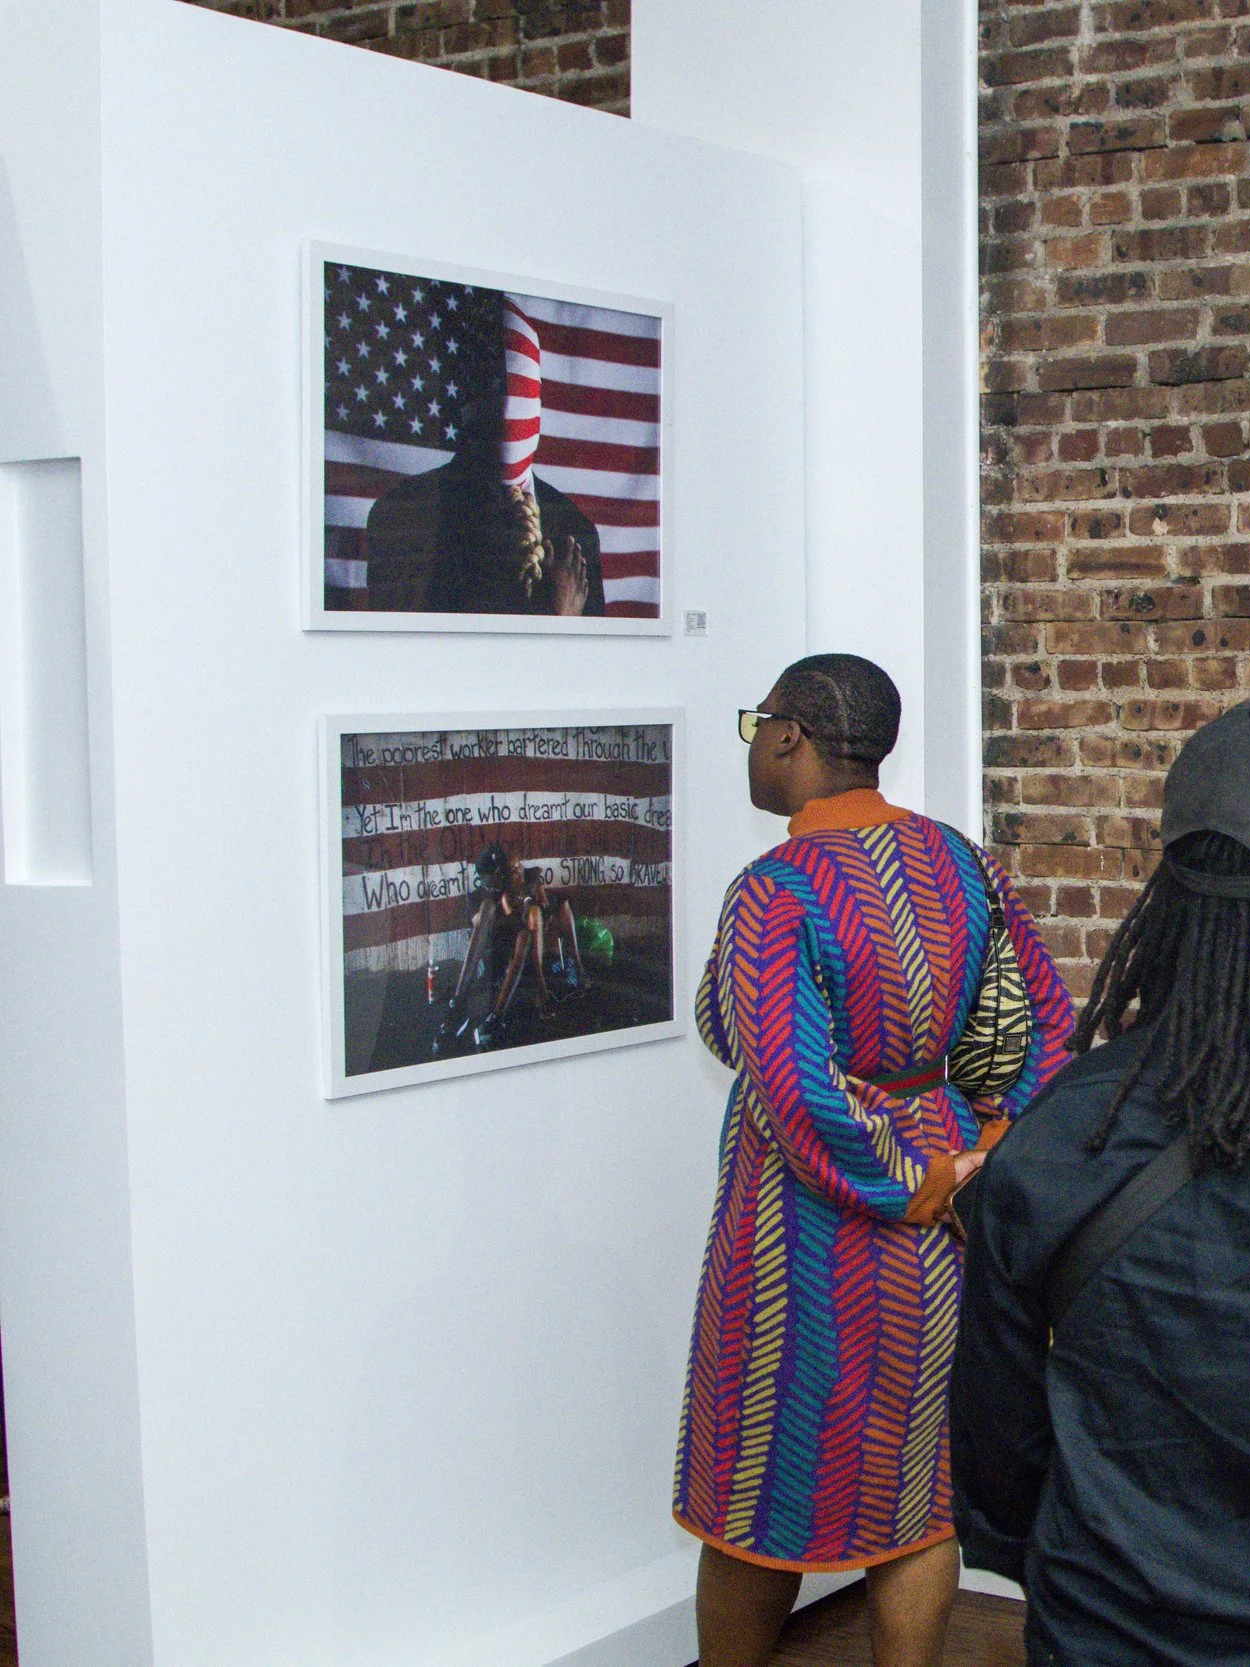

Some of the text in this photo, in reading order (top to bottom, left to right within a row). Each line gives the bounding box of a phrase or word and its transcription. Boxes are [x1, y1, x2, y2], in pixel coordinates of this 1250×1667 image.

[381, 733, 447, 767] poorest
[450, 730, 503, 760] worker
[506, 728, 569, 757] bartered
[633, 729, 657, 761] the
[355, 804, 380, 835] Yet
[414, 801, 441, 829] the
[445, 807, 472, 825] one
[478, 796, 511, 821] who
[518, 793, 570, 821] dreamt
[573, 801, 599, 820] our
[604, 794, 640, 821] basic
[362, 872, 411, 910] Who
[417, 862, 467, 899] dreamt
